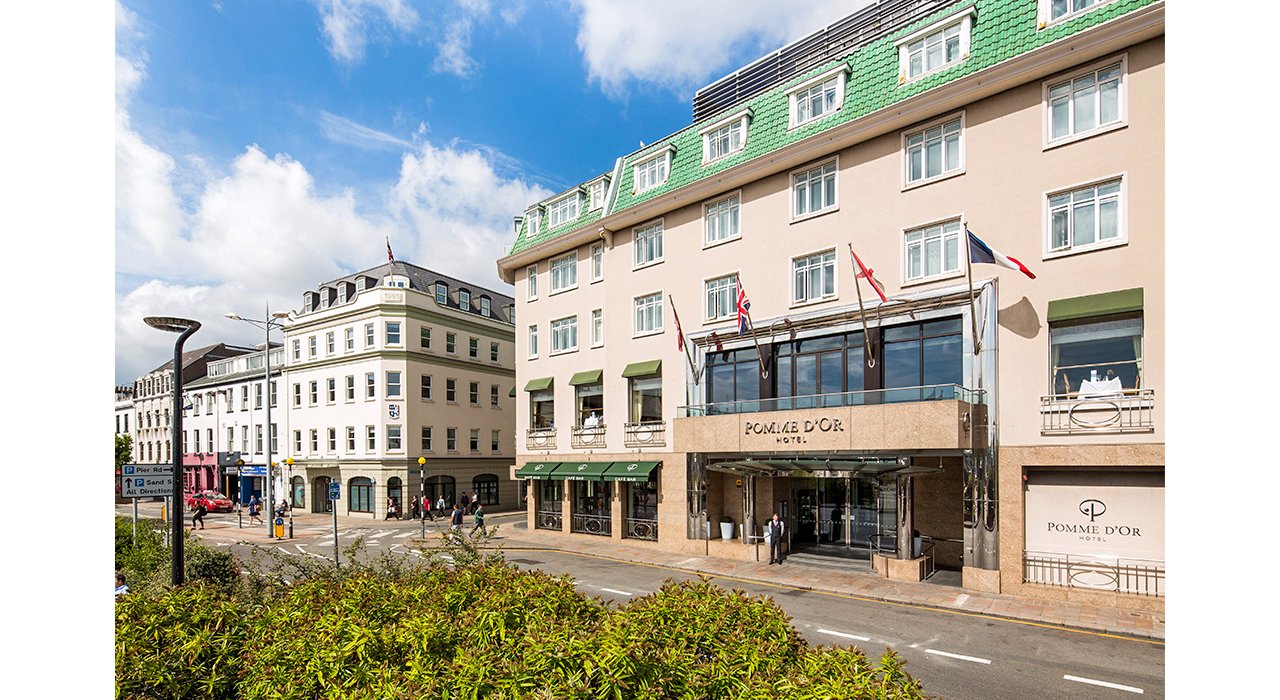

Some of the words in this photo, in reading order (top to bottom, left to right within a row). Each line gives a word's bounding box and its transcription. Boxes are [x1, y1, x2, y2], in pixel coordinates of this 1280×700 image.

[745, 421, 799, 435] POMME
[804, 417, 844, 433] D'OR
[776, 436, 807, 444] HOTEL
[1047, 522, 1100, 535] POMME
[1105, 525, 1142, 537] D'OR
[1079, 535, 1107, 543] HOTEL
